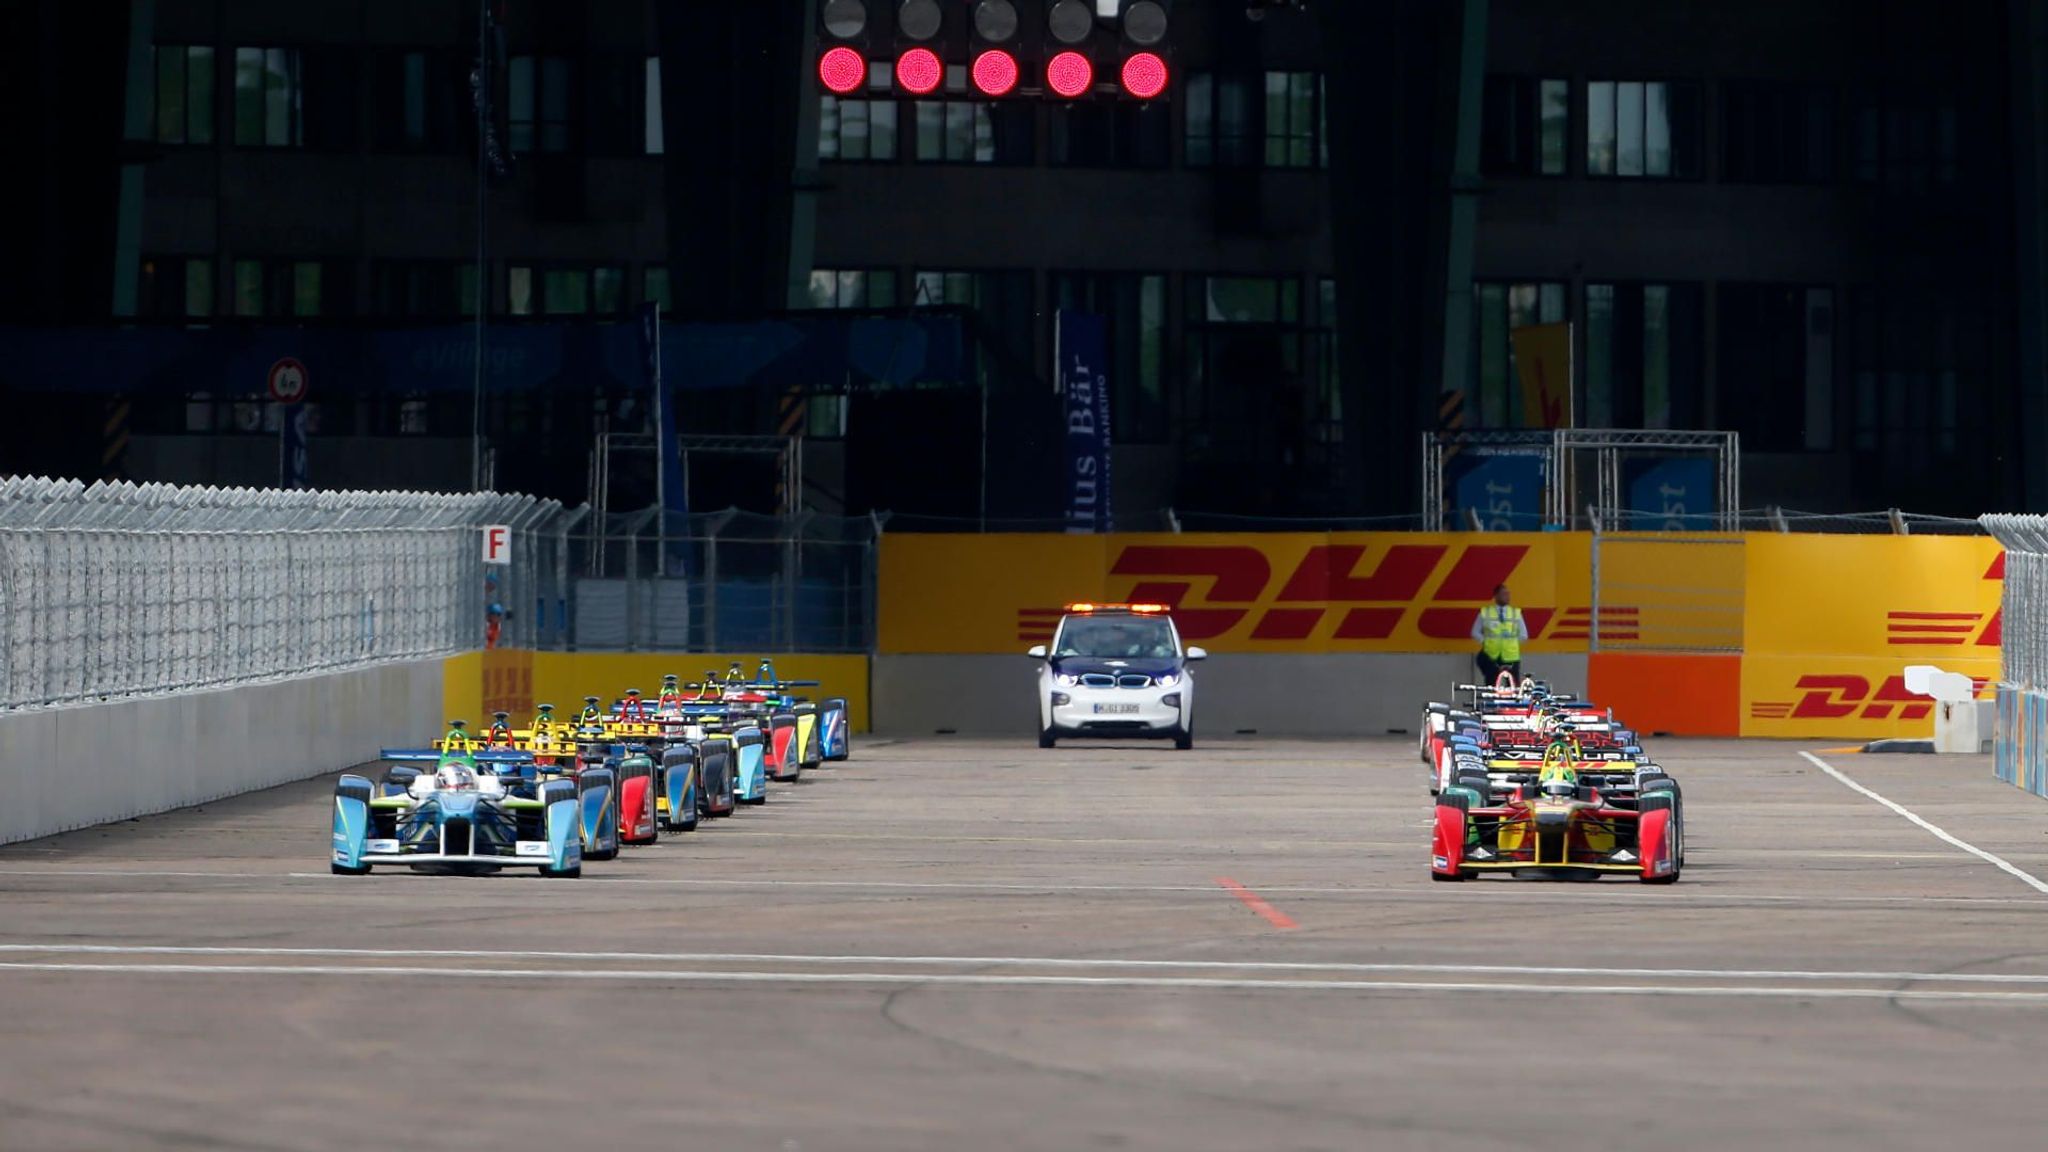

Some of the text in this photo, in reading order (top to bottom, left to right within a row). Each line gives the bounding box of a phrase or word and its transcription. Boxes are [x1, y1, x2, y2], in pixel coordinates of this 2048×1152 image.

[1068, 353, 1096, 434] Bär
[1097, 374, 1113, 448] BANKING
[489, 529, 505, 559] F
[1109, 545, 1556, 639] DHL
[1504, 751, 1628, 760] VEURI
